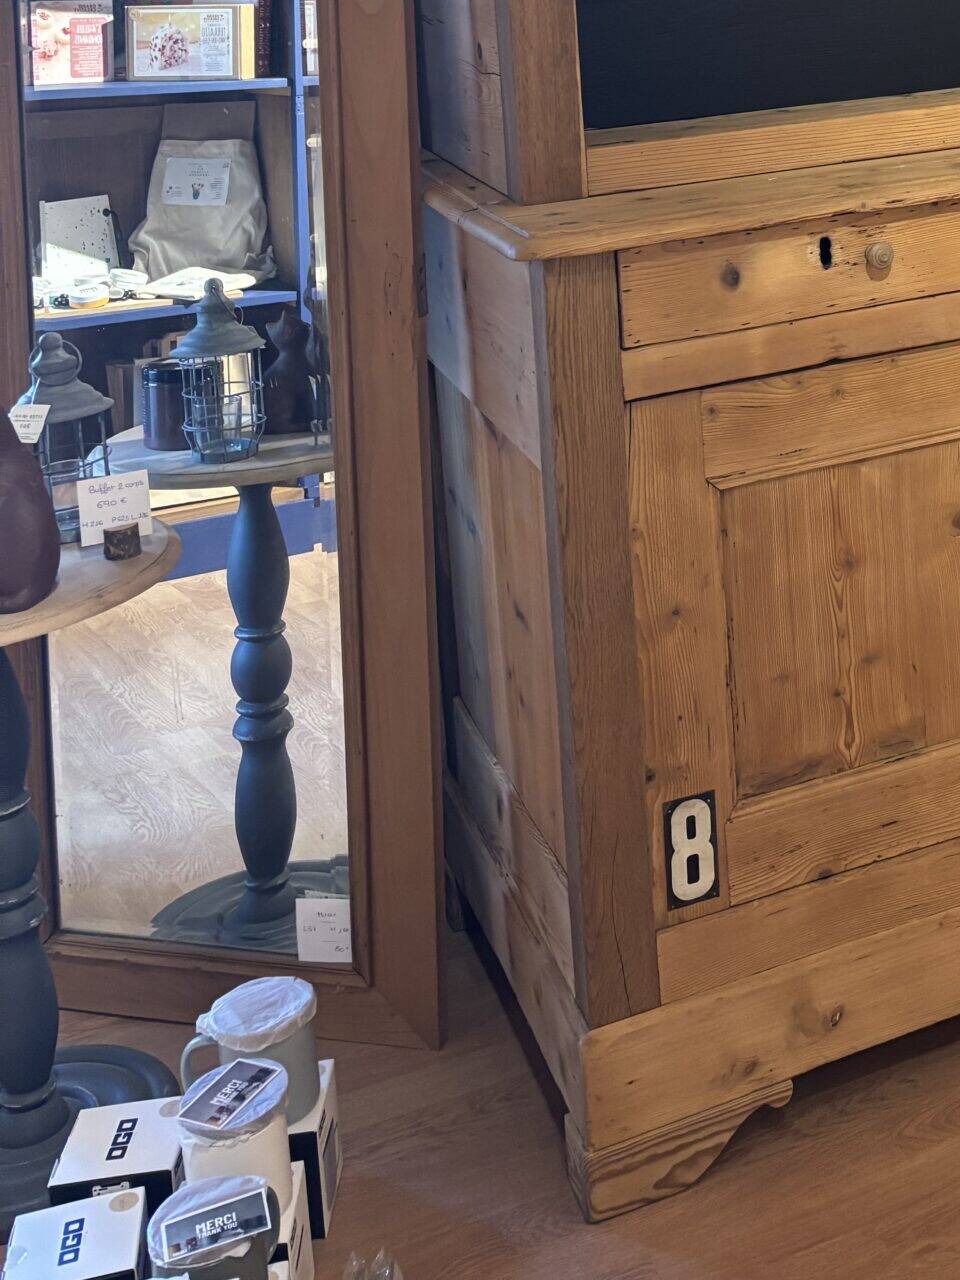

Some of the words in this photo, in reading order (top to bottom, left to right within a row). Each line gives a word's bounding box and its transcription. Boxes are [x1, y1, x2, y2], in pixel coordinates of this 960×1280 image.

[97, 500, 117, 509] 690
[671, 799, 715, 901] 8
[210, 1079, 242, 1106] MERCI
[105, 1117, 139, 1162] OGO
[195, 1212, 237, 1235] MERCI
[198, 1228, 222, 1240] THANK
[224, 1221, 238, 1231] YOU
[57, 1217, 86, 1267] OGO
